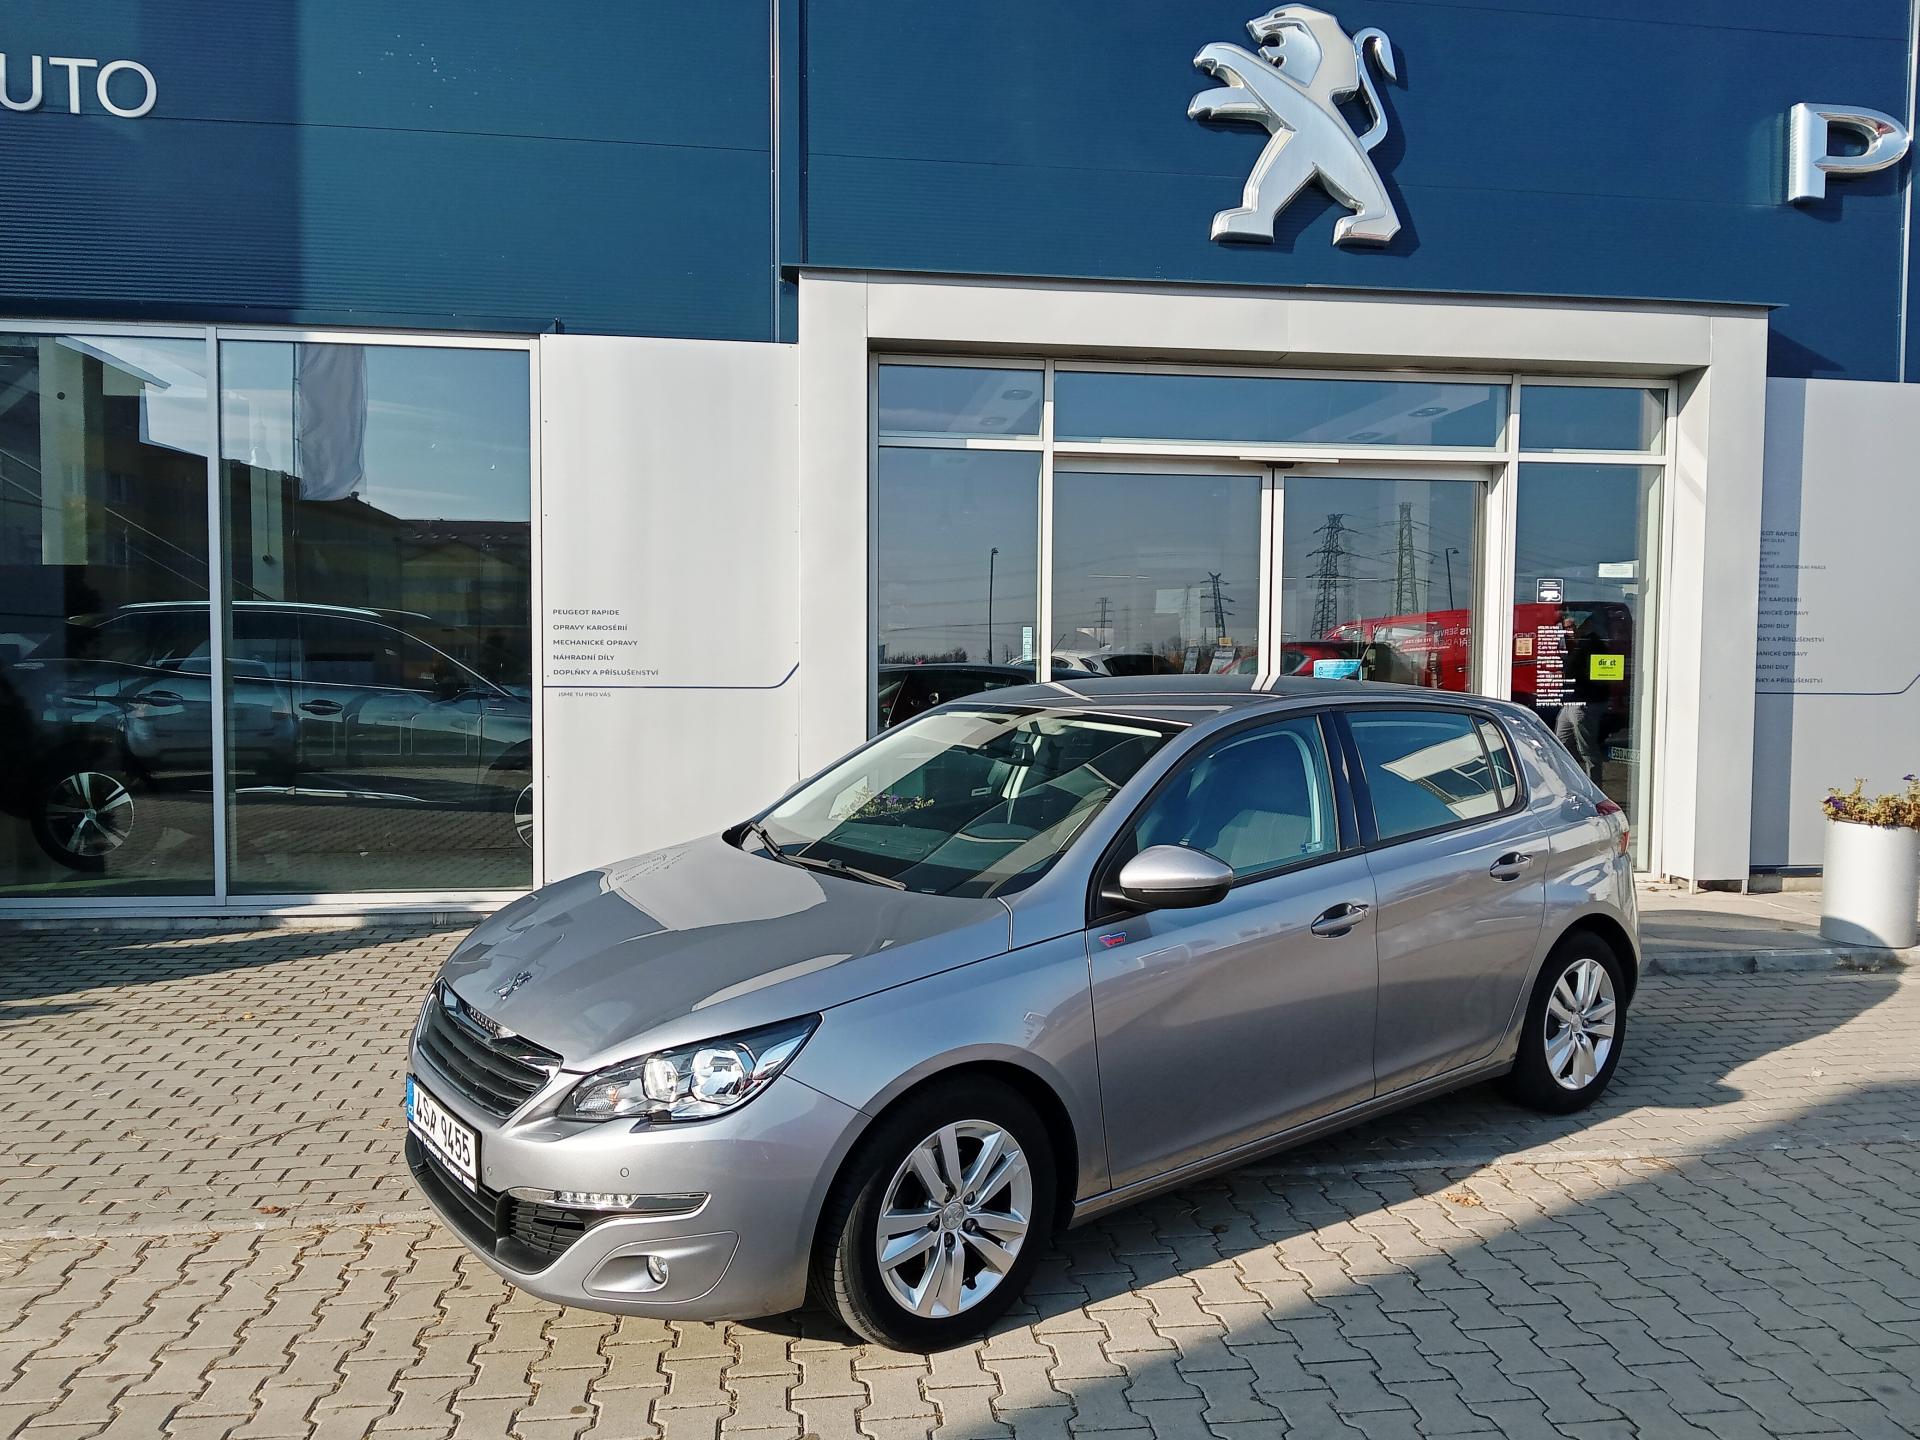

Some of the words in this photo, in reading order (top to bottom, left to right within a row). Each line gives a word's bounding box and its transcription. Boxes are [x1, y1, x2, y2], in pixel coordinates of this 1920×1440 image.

[0, 53, 157, 118] UTO
[1788, 102, 1910, 202] P
[552, 653, 596, 661] NÁHRADNÍ
[597, 653, 615, 661] DÍLY
[553, 668, 591, 676] DOPLŇKY
[600, 668, 659, 676] PŘÍSLUŠENSTVÍ
[440, 1115, 471, 1167] 9455
